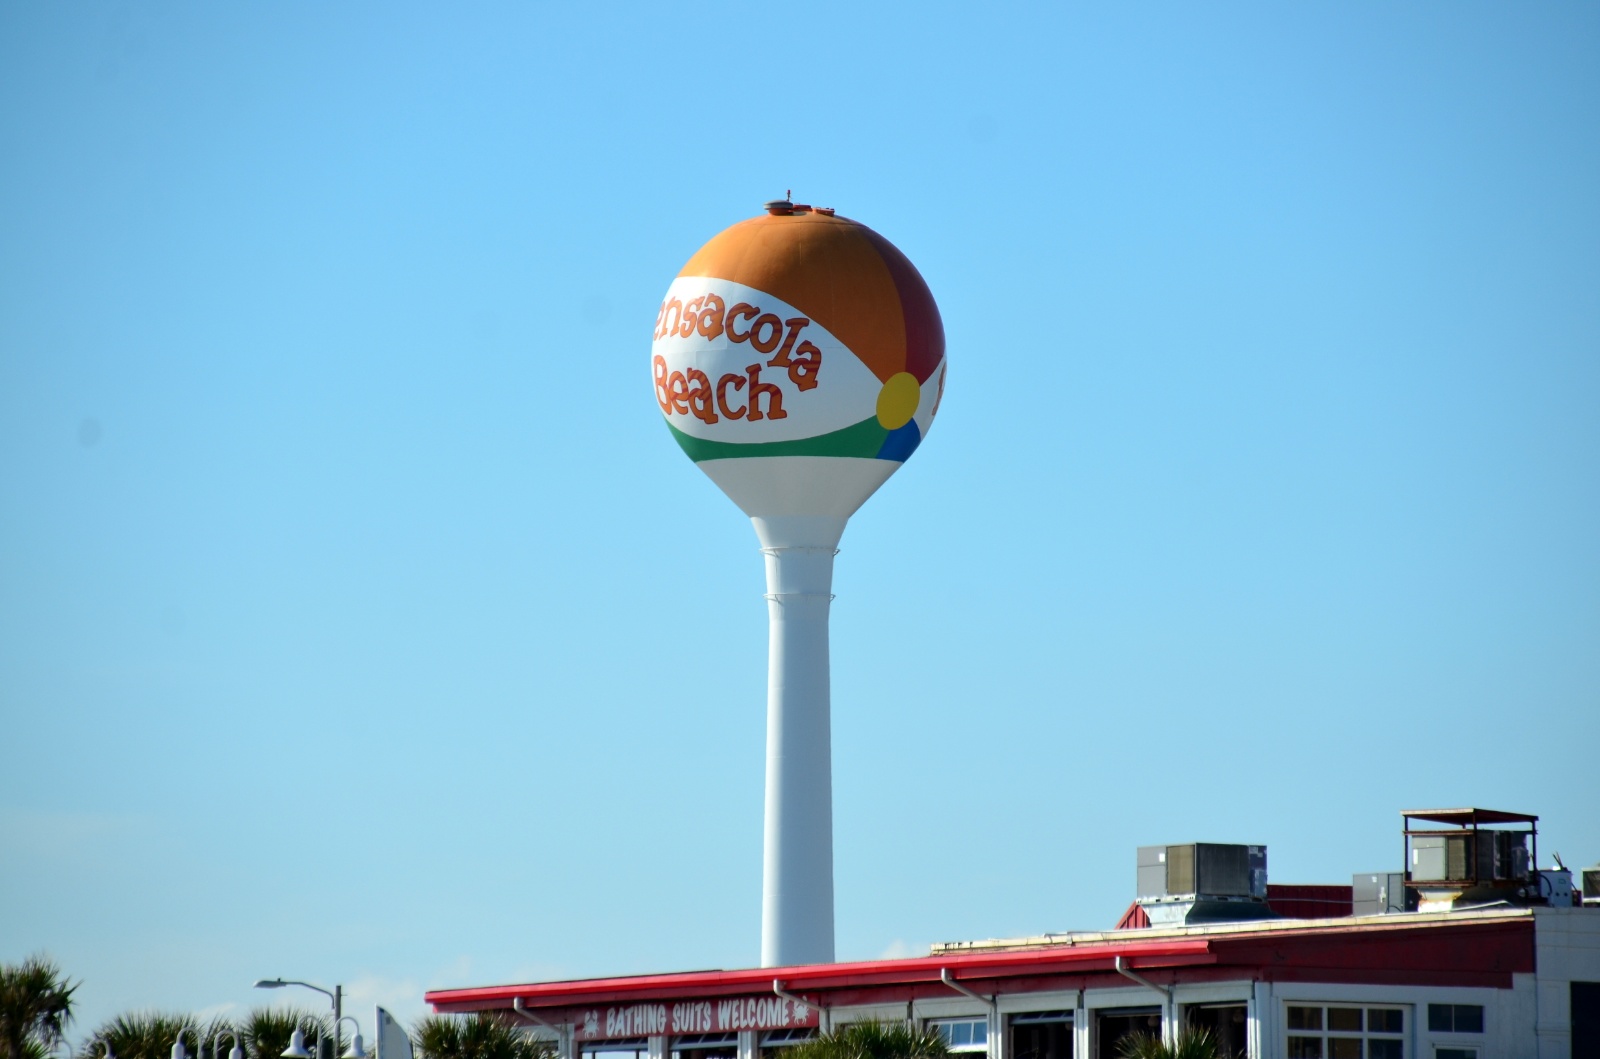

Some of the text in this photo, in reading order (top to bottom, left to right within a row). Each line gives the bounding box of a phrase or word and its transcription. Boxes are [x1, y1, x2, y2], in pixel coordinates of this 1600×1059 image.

[653, 355, 787, 424] Beach
[606, 997, 789, 1036] BATHING SUITS WELCOME
